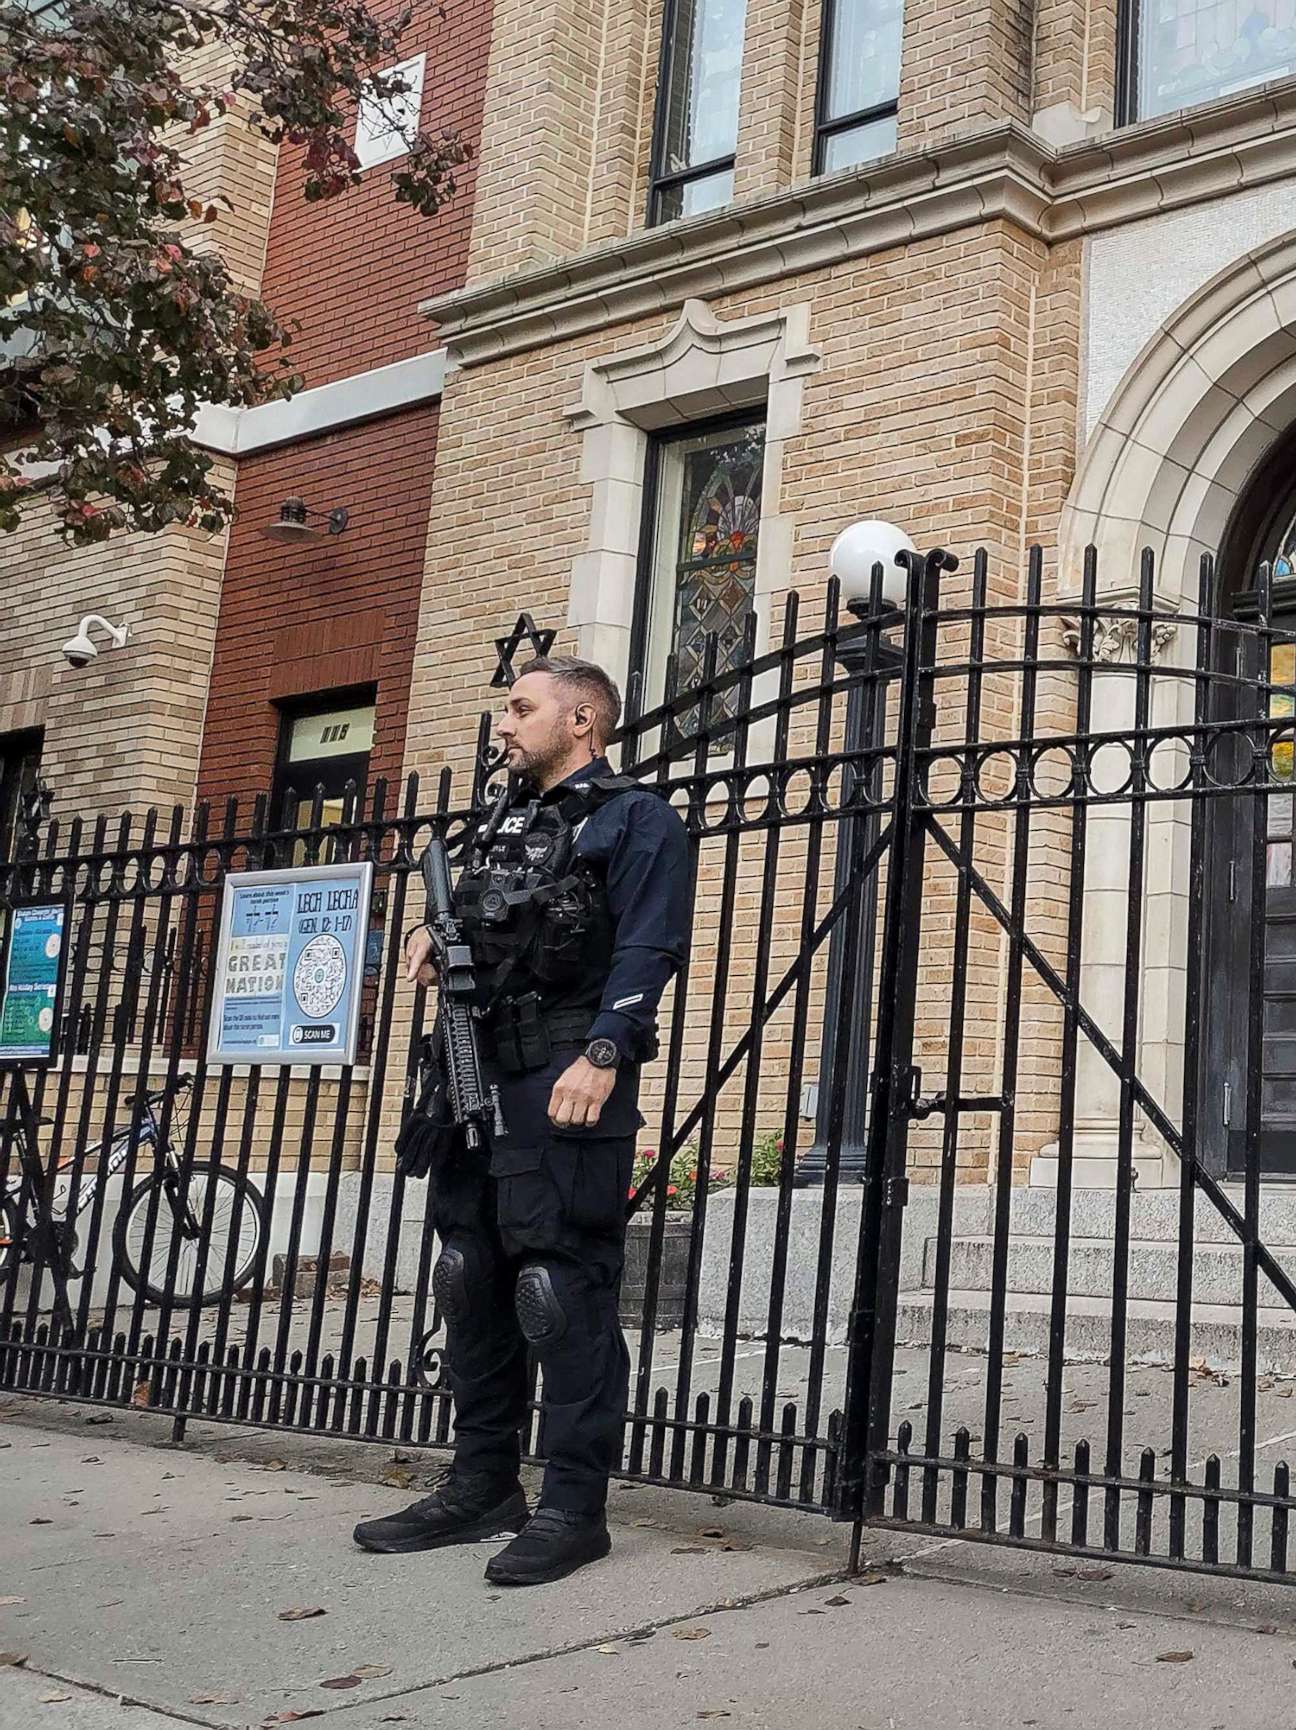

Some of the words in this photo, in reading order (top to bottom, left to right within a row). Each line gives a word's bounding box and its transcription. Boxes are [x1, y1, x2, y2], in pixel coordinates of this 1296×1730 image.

[297, 891, 322, 913] LECH
[326, 888, 358, 911] LECHA
[228, 952, 286, 972] GREAT
[225, 975, 284, 993] NATION
[304, 1029, 320, 1040] SCAN
[321, 1029, 330, 1039] ME
